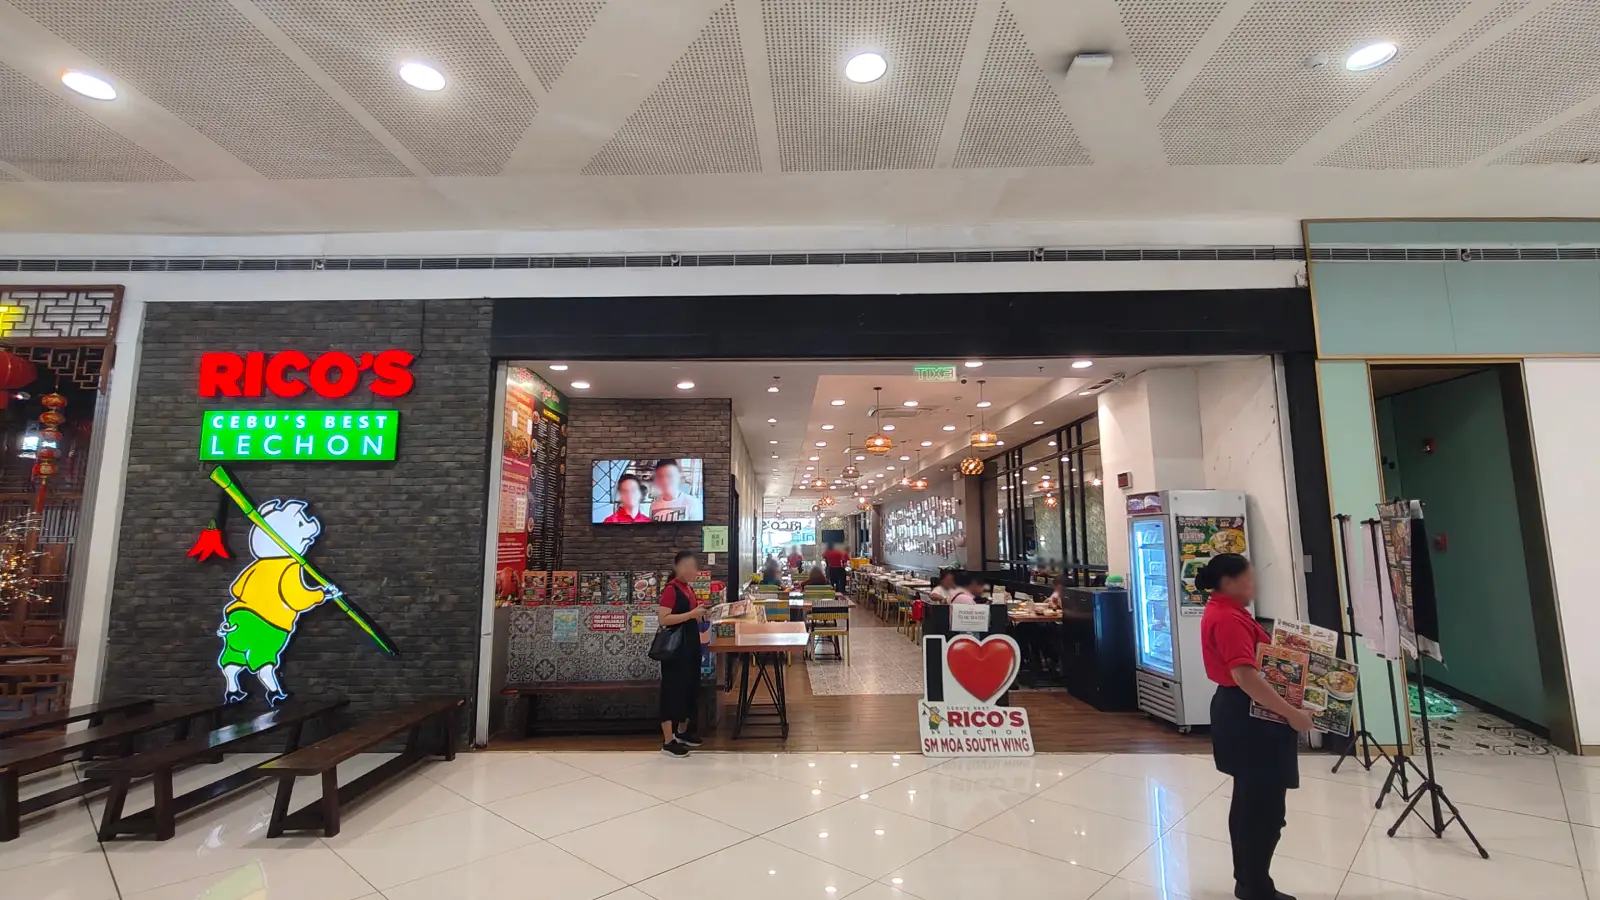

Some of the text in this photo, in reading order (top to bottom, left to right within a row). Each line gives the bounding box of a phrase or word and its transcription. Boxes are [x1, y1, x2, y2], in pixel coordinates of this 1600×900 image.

[200, 350, 413, 398] RICO'S
[212, 415, 388, 429] CEBU'S BEST
[211, 434, 383, 455] LECHON
[926, 638, 944, 702] I
[947, 711, 1025, 727] RICO'S
[924, 738, 1030, 752] SM MOA SOUTH WING
